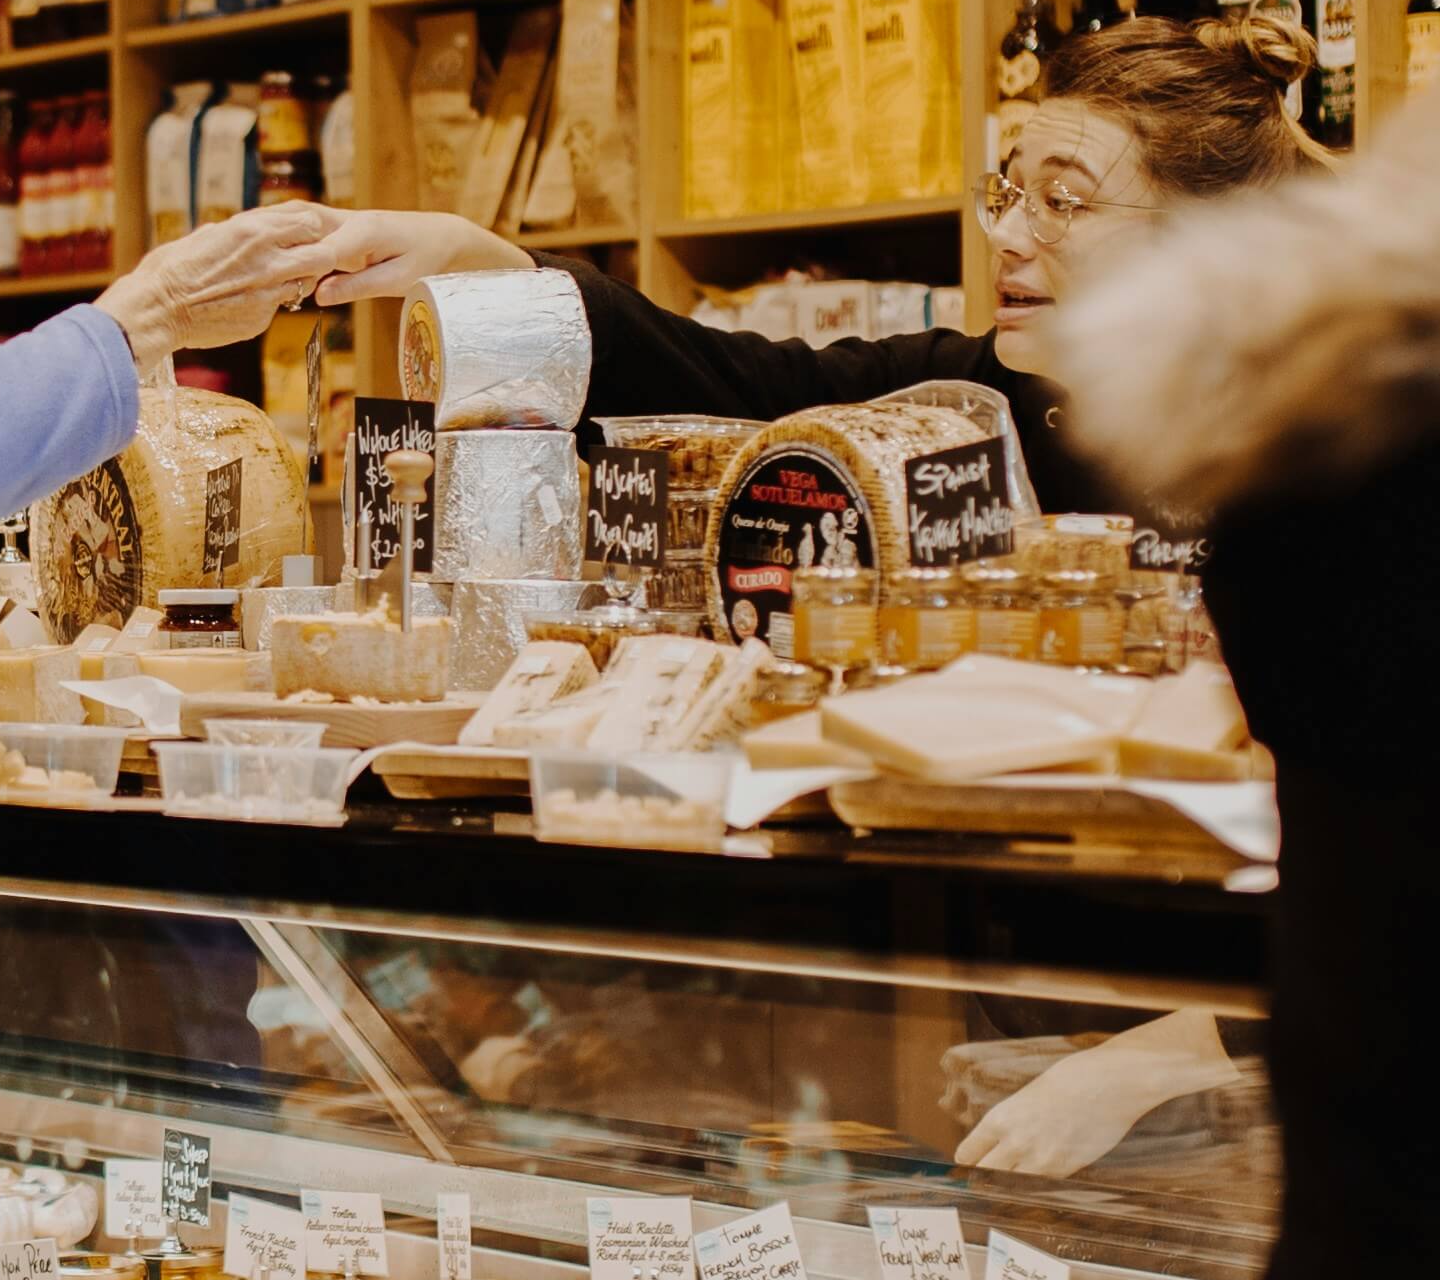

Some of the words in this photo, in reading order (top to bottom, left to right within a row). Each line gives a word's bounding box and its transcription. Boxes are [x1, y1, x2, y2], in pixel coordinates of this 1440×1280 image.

[779, 470, 818, 489] VEGA
[751, 484, 849, 511] SOTUELAMOS
[735, 572, 782, 588] CURADO
[607, 1221, 633, 1236] Heidi
[635, 1221, 675, 1236] Raclette
[594, 1234, 647, 1250] Tasmanian
[648, 1235, 690, 1250] Washed
